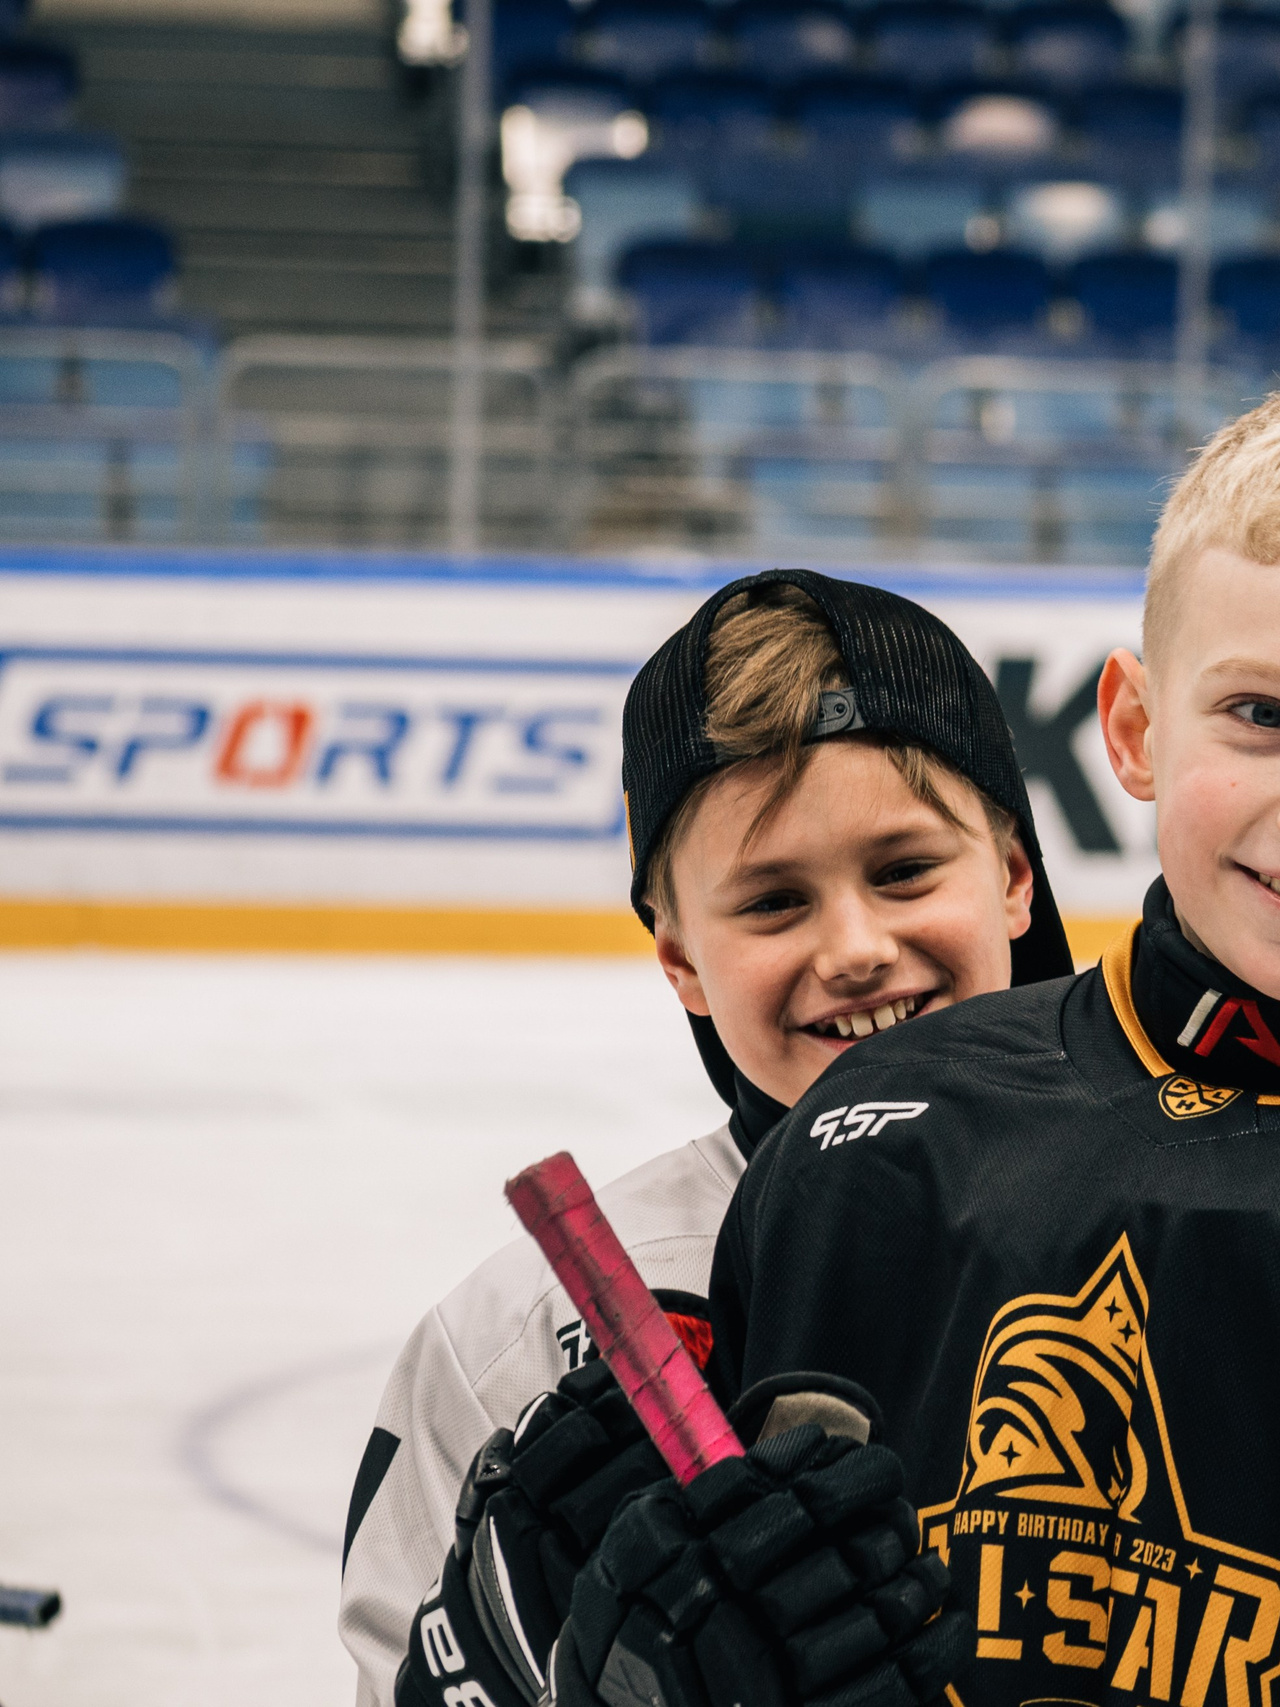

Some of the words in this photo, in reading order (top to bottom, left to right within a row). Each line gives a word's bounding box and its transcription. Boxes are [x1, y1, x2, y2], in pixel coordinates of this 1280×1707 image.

[0, 692, 608, 794] SPORTS
[953, 1509, 1010, 1537] HAPPY
[1016, 1512, 1110, 1547] BIRTHDAY
[1128, 1532, 1178, 1573] 2023
